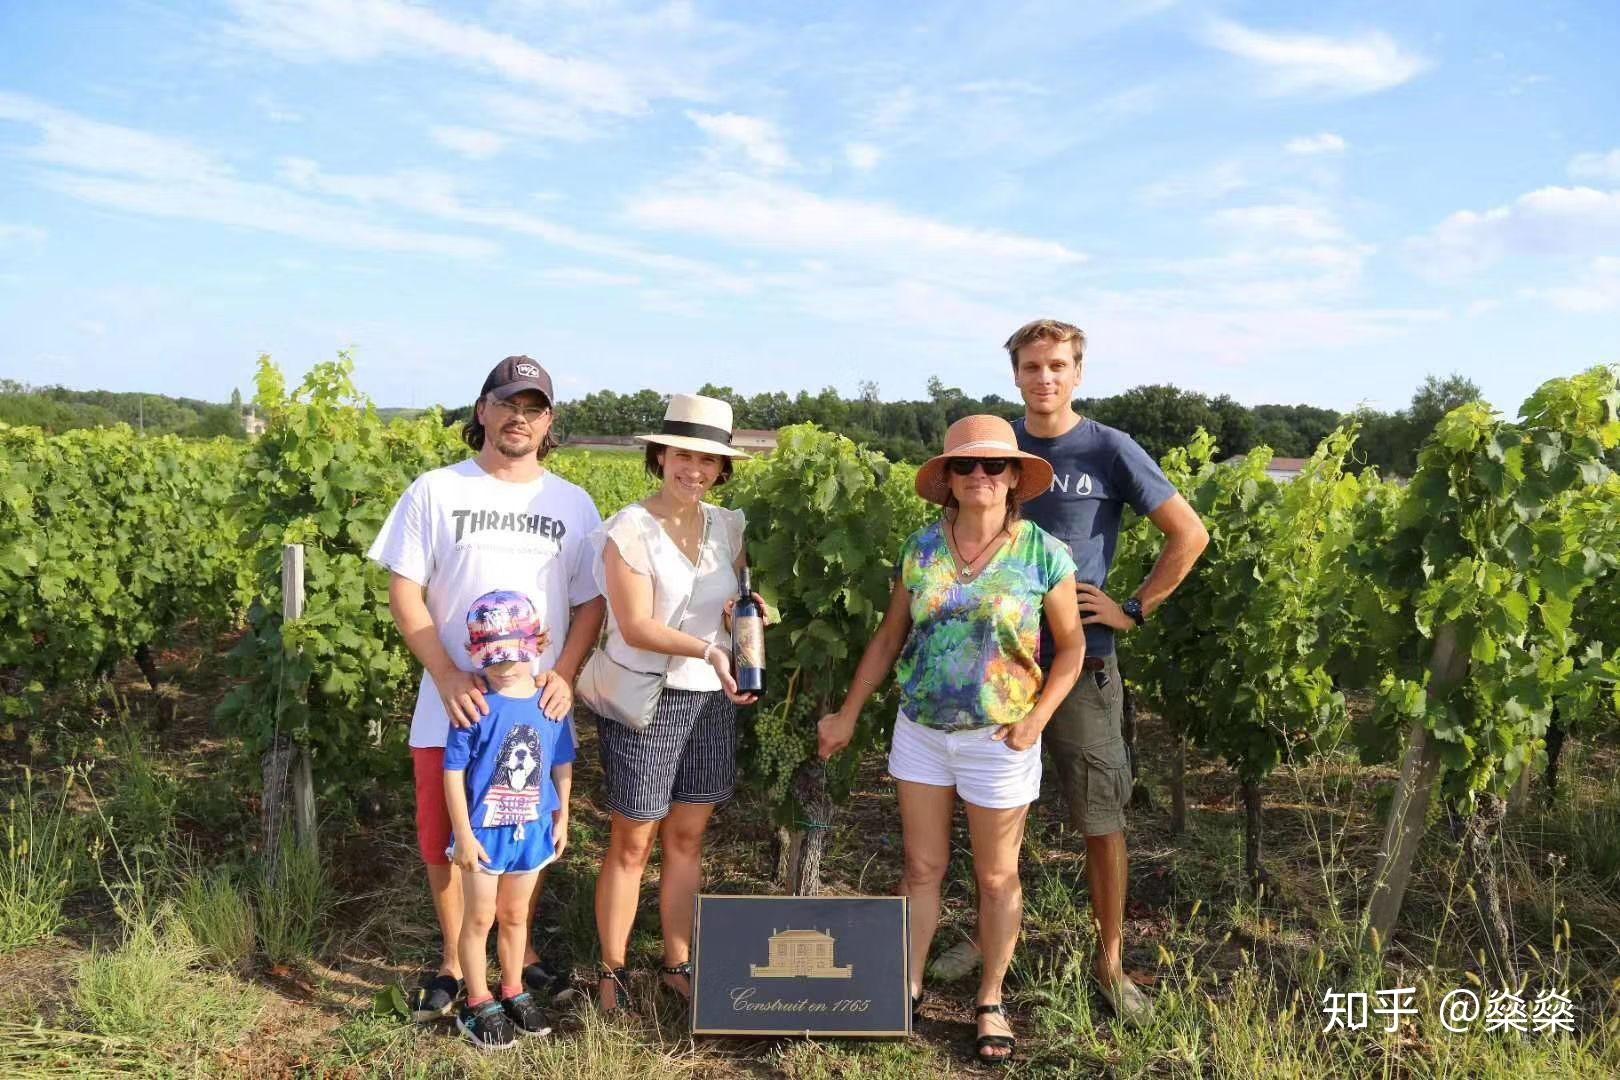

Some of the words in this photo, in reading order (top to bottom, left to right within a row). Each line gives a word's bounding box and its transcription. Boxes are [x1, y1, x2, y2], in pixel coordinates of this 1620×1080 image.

[452, 509, 567, 552] THRASHER
[729, 986, 808, 1012] Construit
[808, 1003, 828, 1012] en
[831, 999, 872, 1013] 1765
